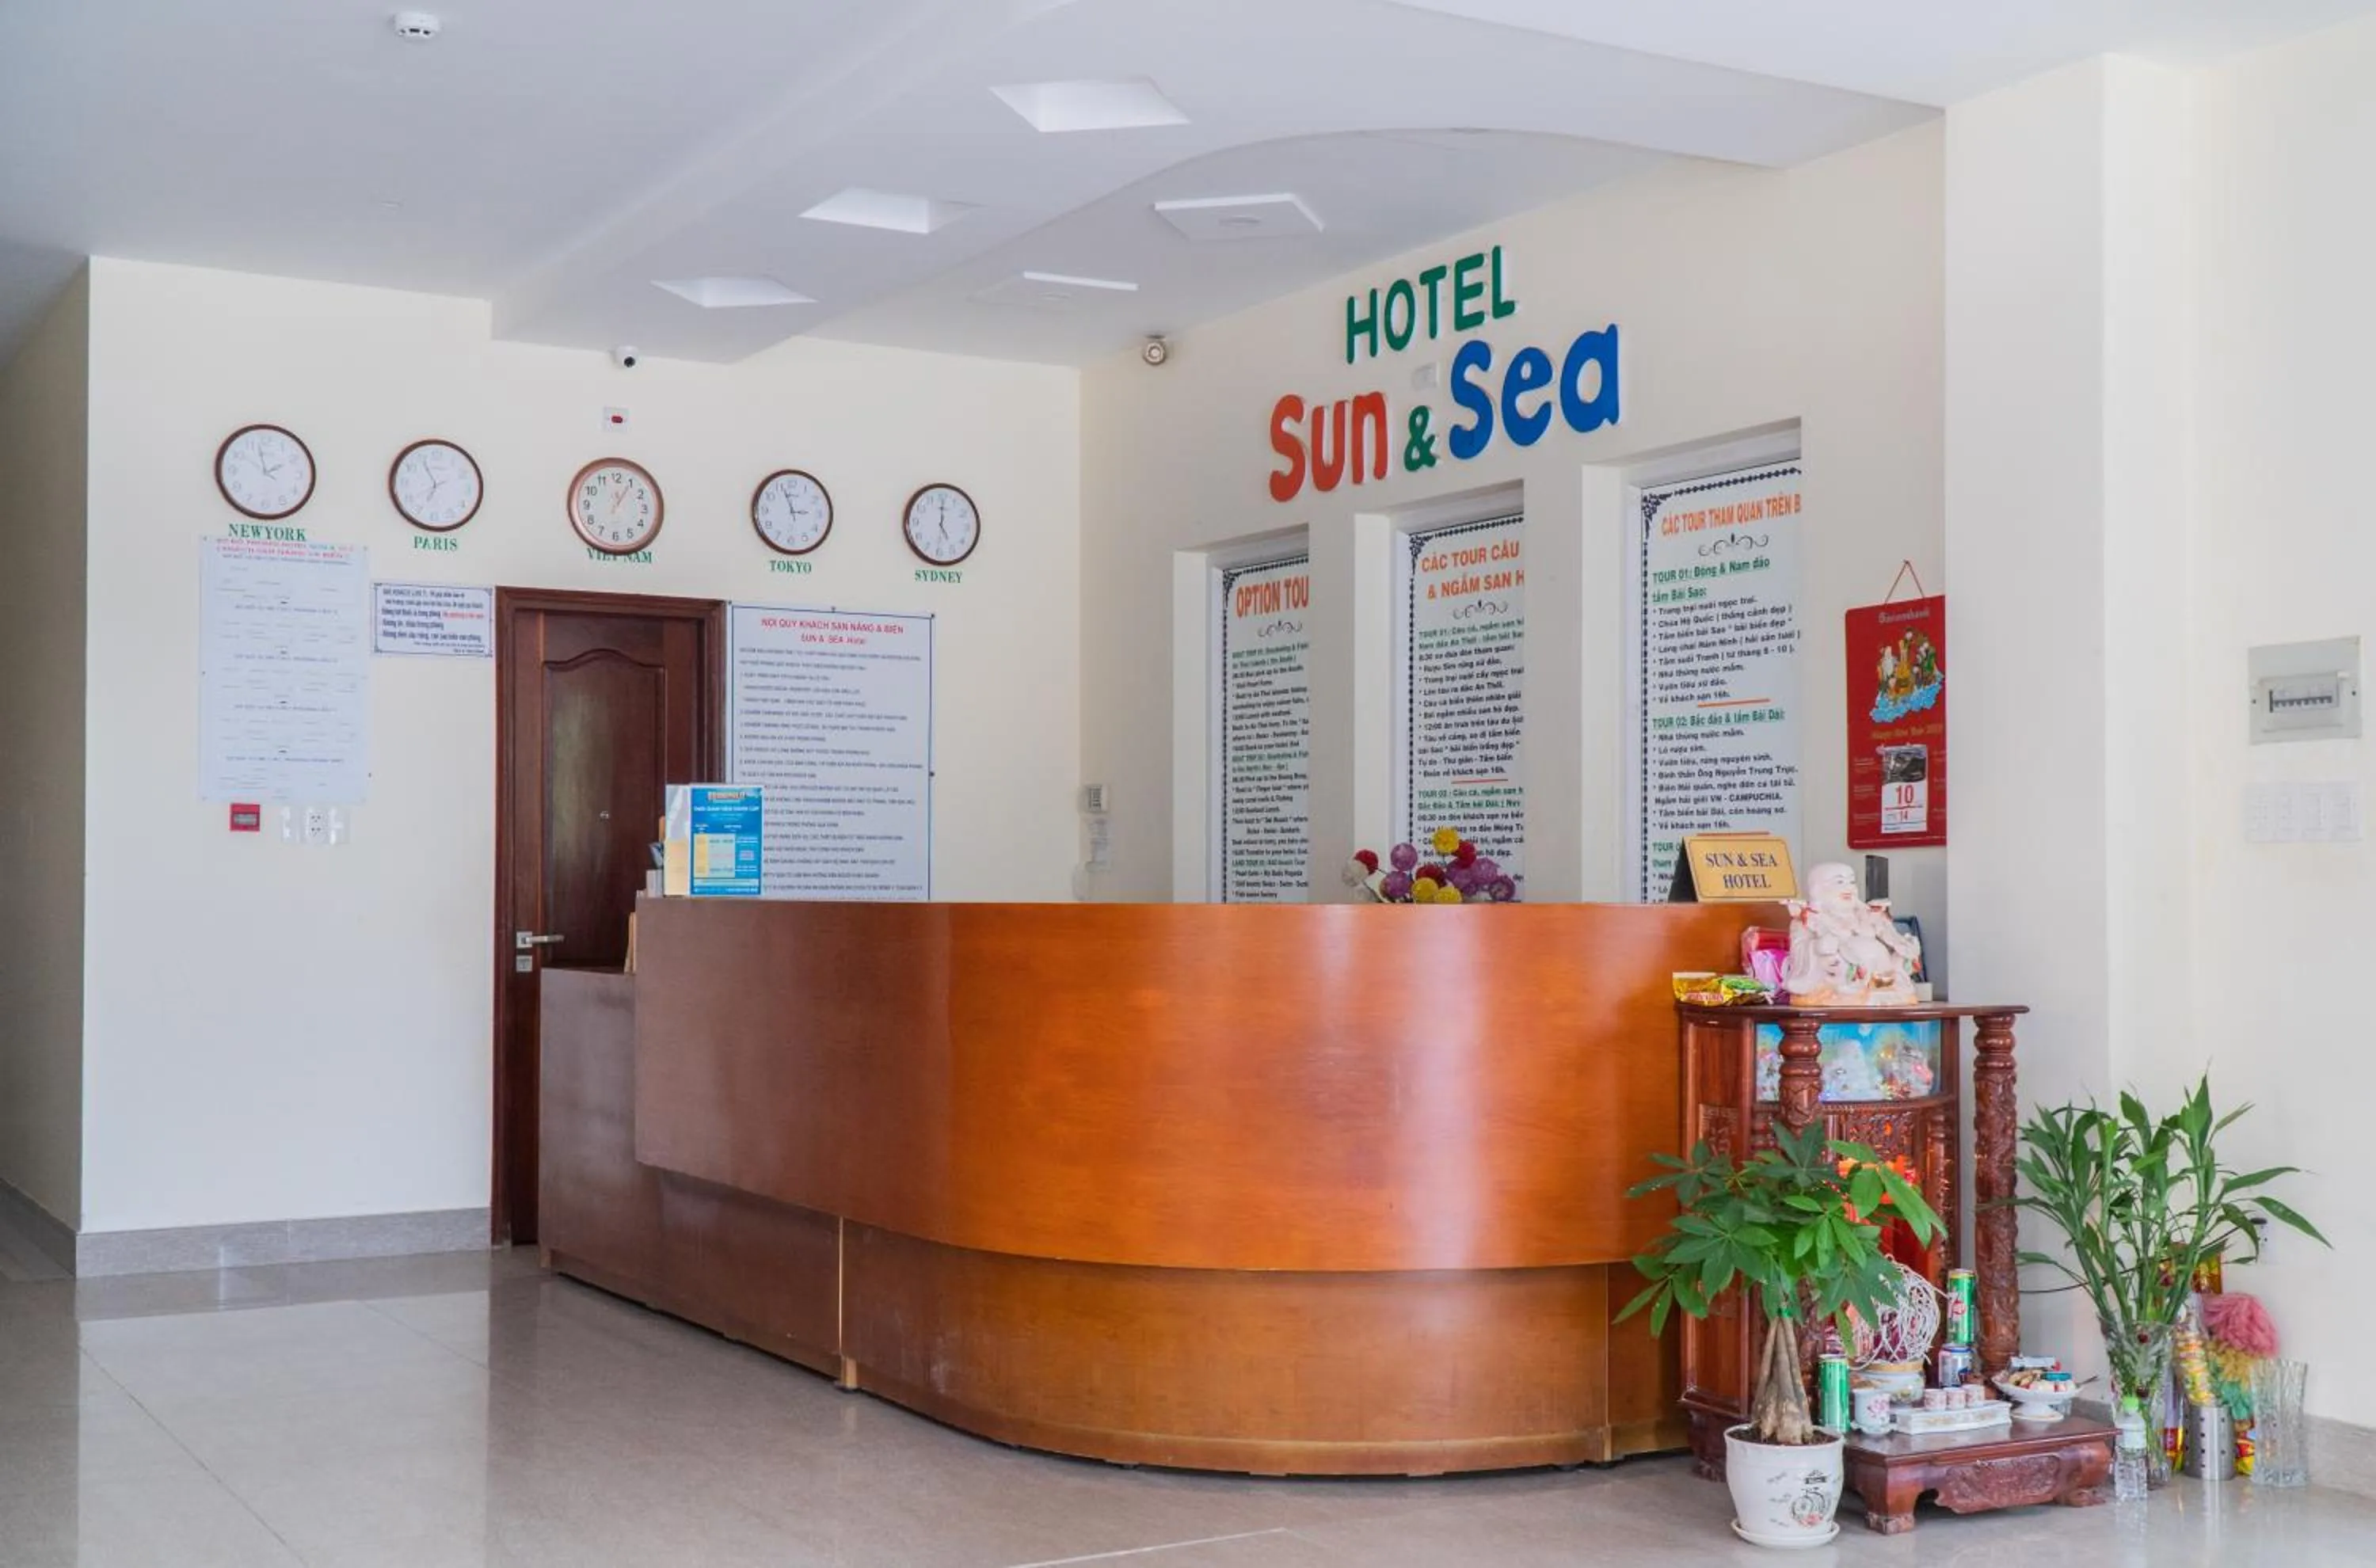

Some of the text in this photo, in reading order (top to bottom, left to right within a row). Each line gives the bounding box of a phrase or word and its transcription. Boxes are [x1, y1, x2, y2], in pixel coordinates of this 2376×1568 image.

[1346, 245, 1517, 364] HOTEL
[1268, 322, 1620, 503] Sun & Sea
[598, 476, 632, 488] 11 1
[612, 473, 621, 483] 12
[585, 486, 644, 500] 10 2
[584, 500, 648, 514] 9 3
[1682, 512, 1705, 533] TOUR
[1708, 506, 1734, 529] THAM
[1737, 500, 1763, 525] QUAN
[1795, 493, 1801, 514] B
[588, 515, 594, 524] 8
[228, 523, 306, 542] NEWYORK
[598, 526, 634, 541] 7 6 5
[414, 536, 457, 551] PARIS
[624, 551, 652, 563] NAM
[1422, 552, 1448, 572] CÁC
[1451, 547, 1487, 567] TOUR
[770, 561, 812, 573] TOKYO
[1652, 569, 1677, 583] TOUR
[1719, 562, 1726, 574] &
[1729, 560, 1750, 572] Nam
[914, 570, 962, 583] SYDNEY
[1428, 584, 1436, 599] &
[1484, 571, 1511, 591] SAN
[1516, 570, 1524, 585] H
[1237, 577, 1308, 618] OPTION TOU
[829, 635, 843, 644] SEA
[1653, 717, 1673, 729] TOUR
[1725, 712, 1731, 723] &
[1729, 793, 1783, 802] CAMPUCHIA.
[1895, 785, 1913, 804] 10
[1706, 852, 1777, 867] SUN & SEA
[1723, 873, 1772, 889] HOTEL
